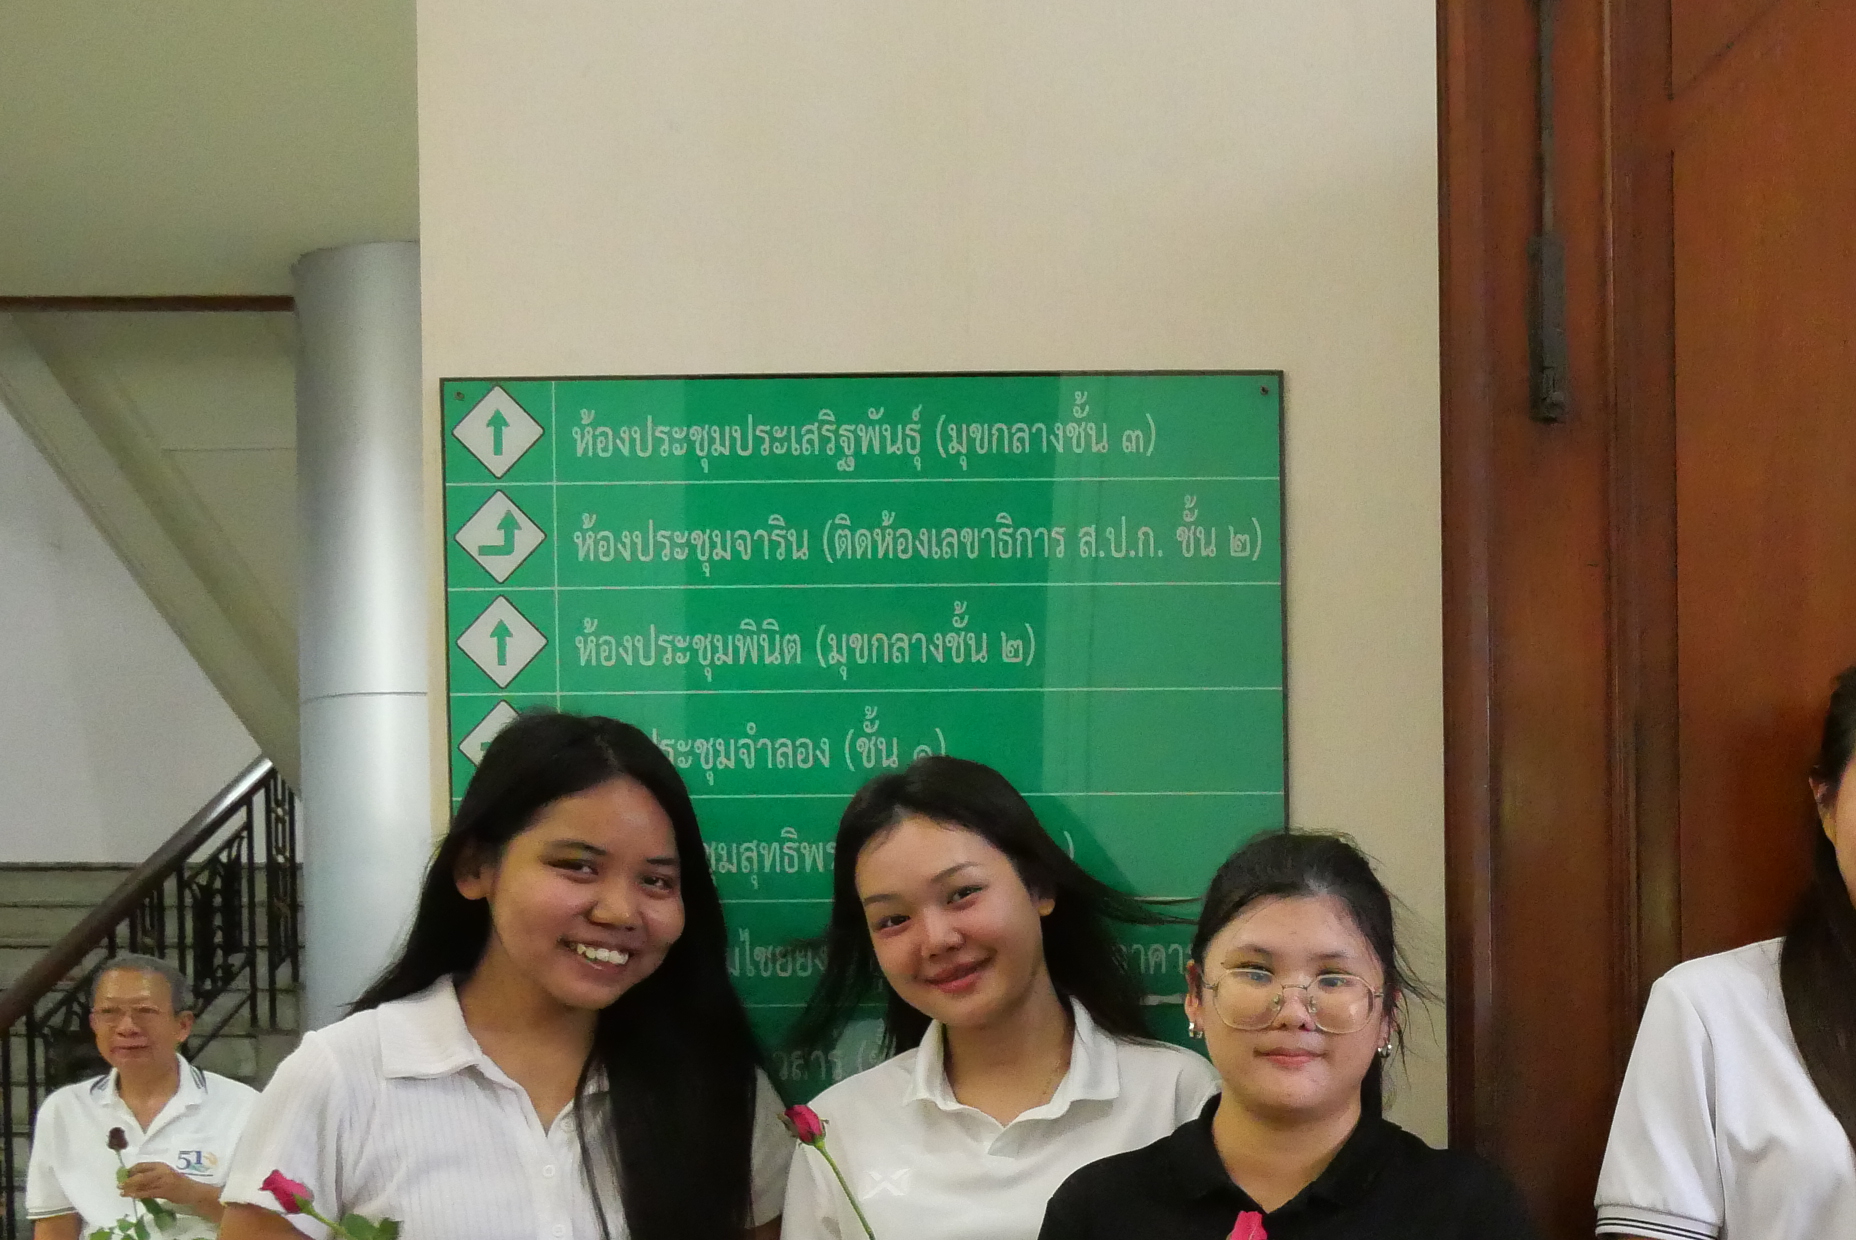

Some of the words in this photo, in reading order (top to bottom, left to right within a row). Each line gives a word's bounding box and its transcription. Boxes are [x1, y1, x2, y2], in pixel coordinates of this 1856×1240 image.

[572, 403, 922, 473] ห้องประชุมประเสริฐพันธุ์
[936, 391, 1108, 470] (มุขกลางชั้น
[1122, 413, 1156, 456] ๓)
[573, 512, 809, 577] ห้องประชุมจาริน
[823, 510, 1066, 563] (ติดห้องเลขาธิการ
[1078, 516, 1163, 558] ส.ป.ก.
[1176, 495, 1216, 558] ชั้น
[1228, 517, 1262, 561] ๒)
[575, 618, 801, 682] ห้องประชุมพินิต
[816, 600, 987, 680] (มุขกลางชั้น
[1001, 624, 1036, 667] ๒)
[845, 706, 898, 772] (ชั้น
[176, 1150, 203, 1170] 51
